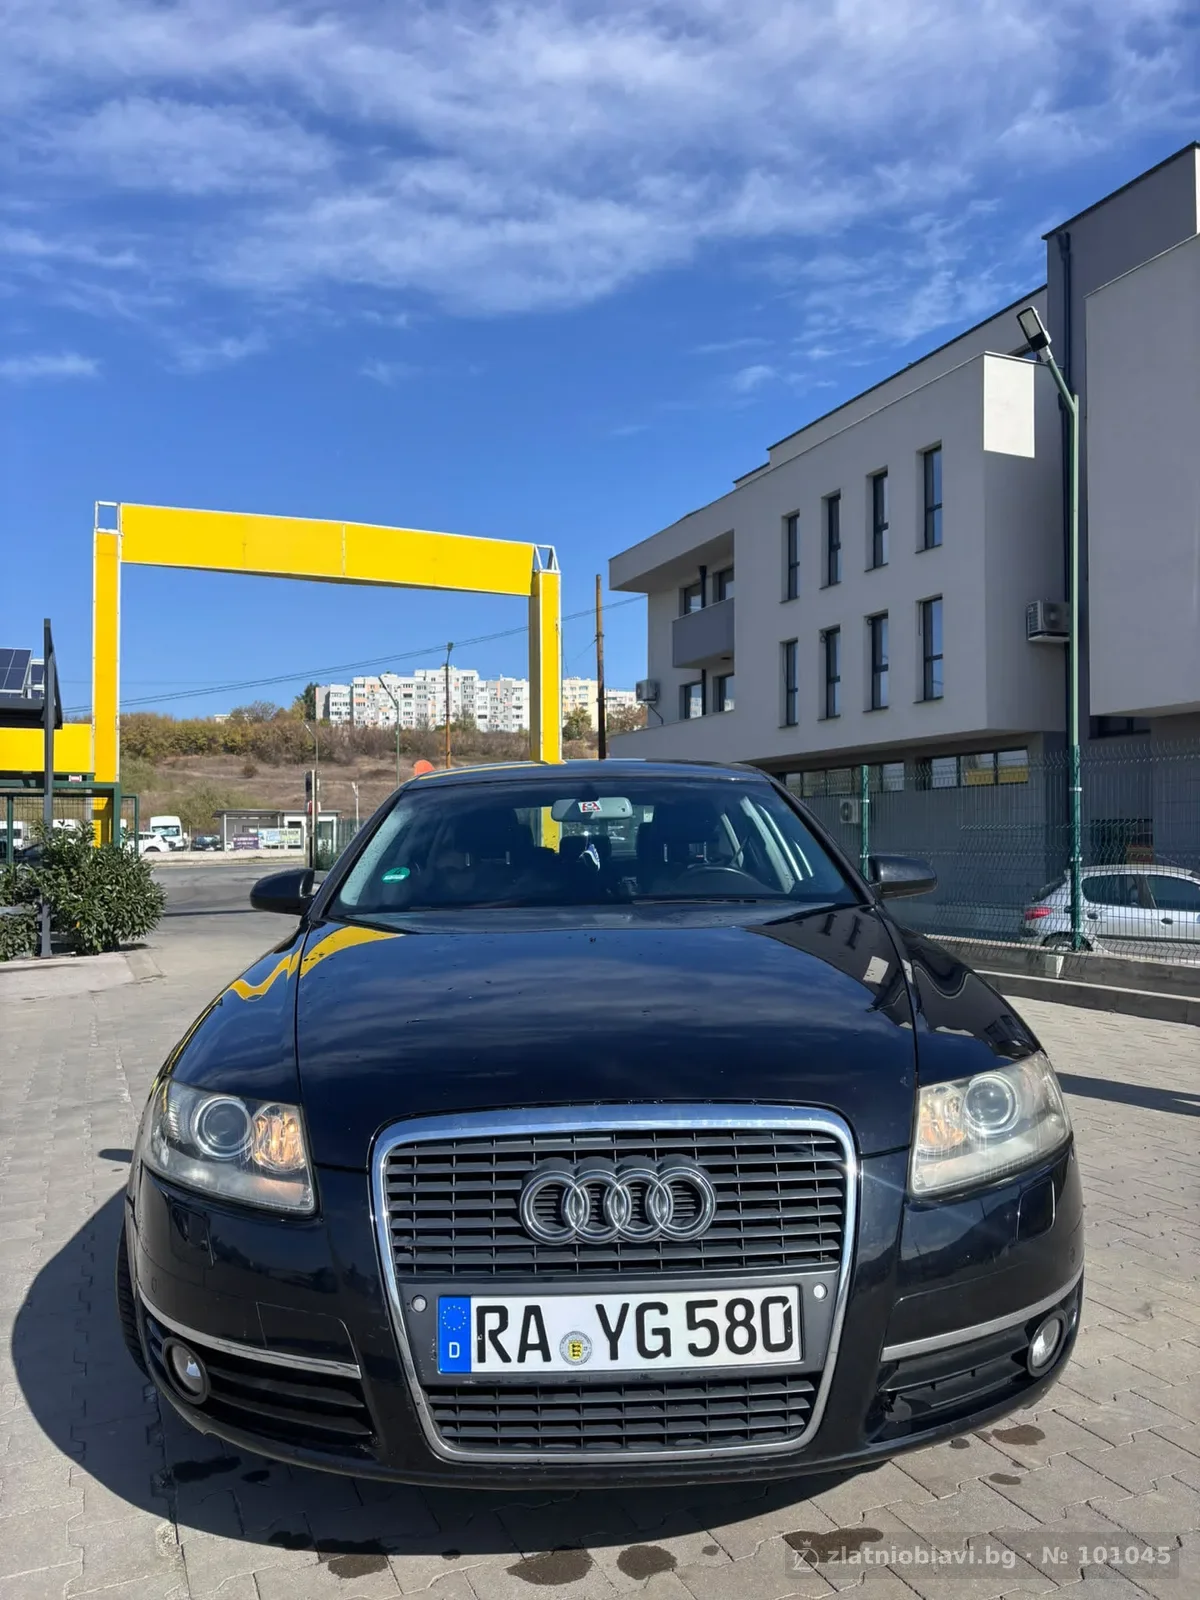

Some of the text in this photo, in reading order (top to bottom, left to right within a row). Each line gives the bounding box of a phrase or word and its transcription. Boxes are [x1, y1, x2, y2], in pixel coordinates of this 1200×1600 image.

[448, 1341, 461, 1359] D
[476, 1305, 551, 1364] RA
[595, 1302, 672, 1361] YG
[686, 1296, 794, 1358] 580
